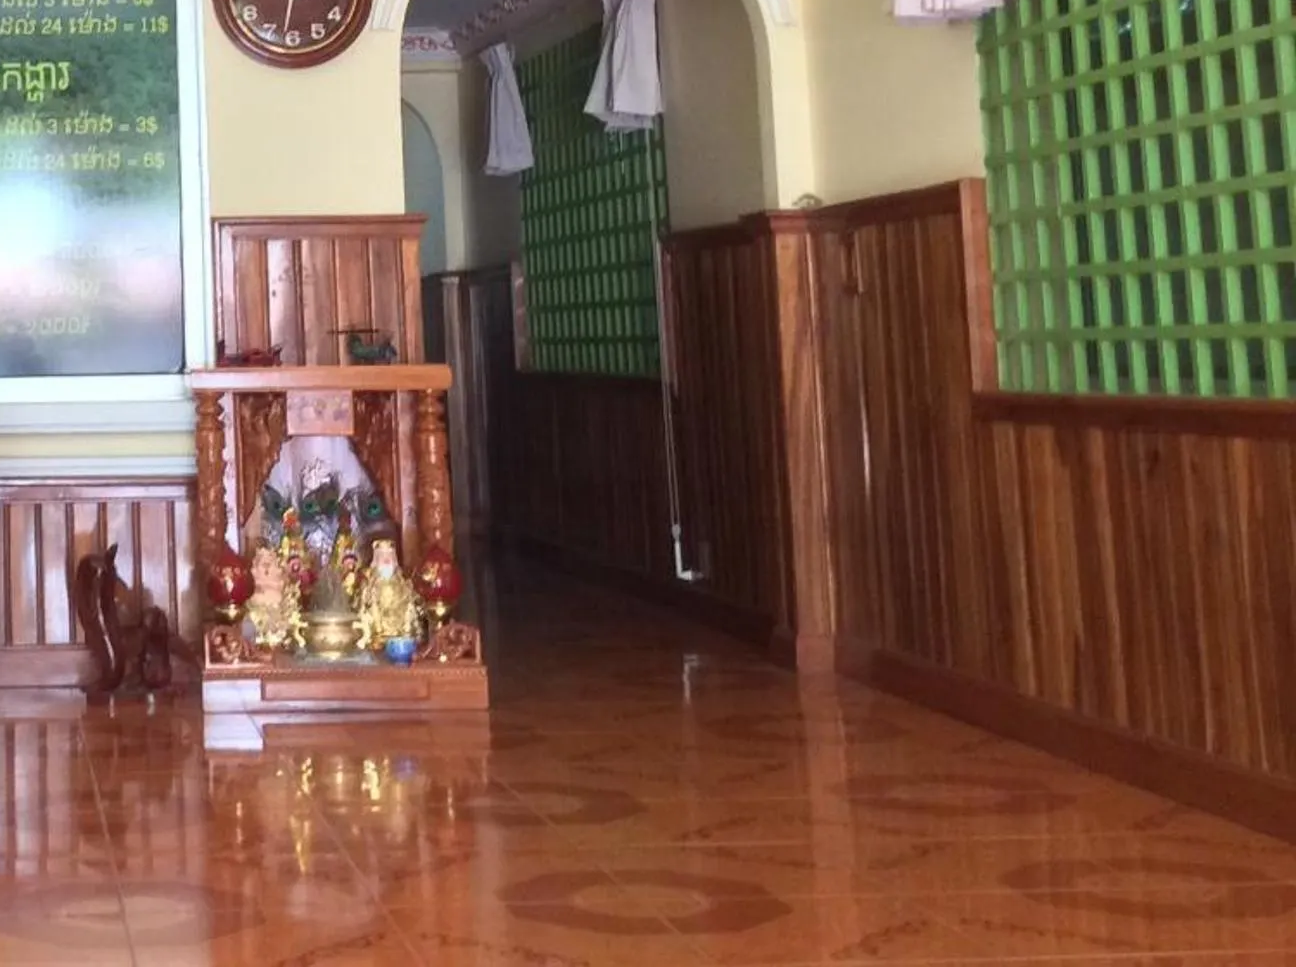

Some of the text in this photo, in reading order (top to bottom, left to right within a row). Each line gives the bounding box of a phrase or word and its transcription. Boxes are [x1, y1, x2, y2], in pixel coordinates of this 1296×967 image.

[243, 6, 257, 21] 8
[328, 7, 341, 21] 4
[41, 17, 63, 36] 24
[262, 24, 277, 40] 7
[311, 23, 326, 40] 5
[285, 31, 300, 46] 6
